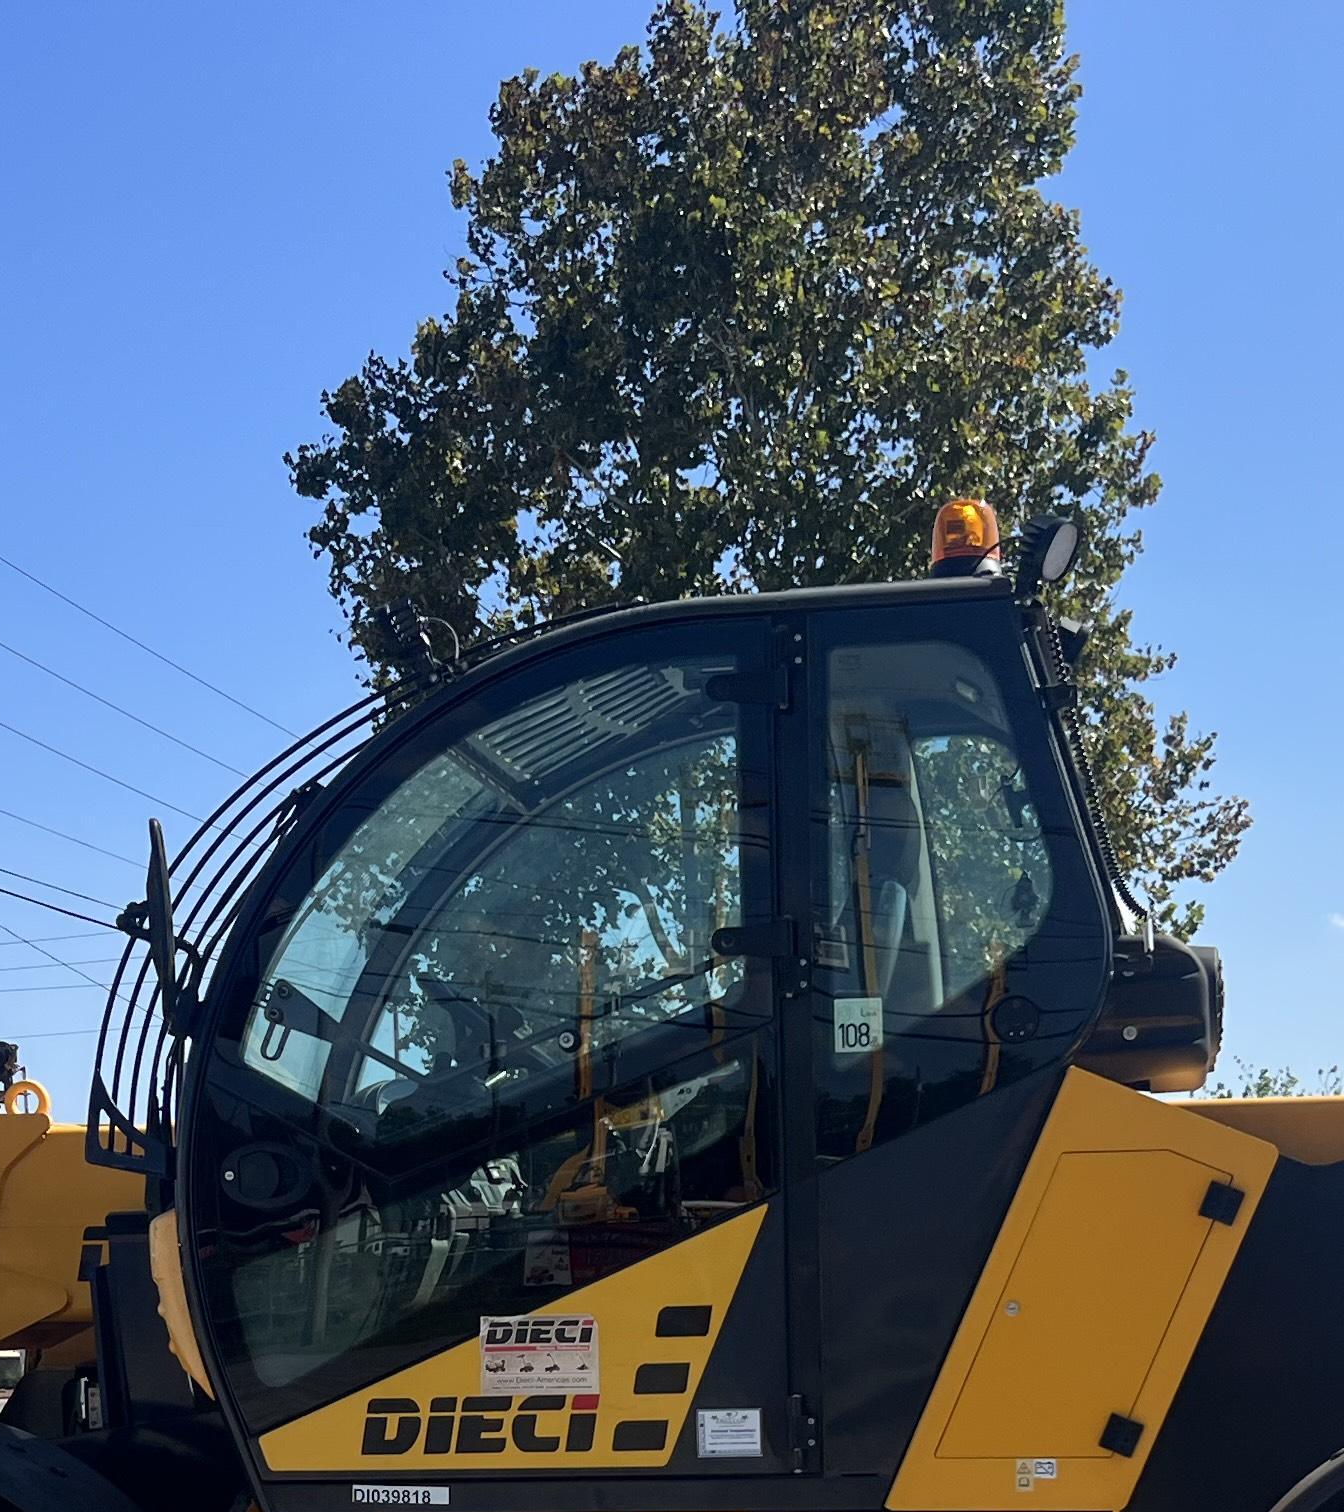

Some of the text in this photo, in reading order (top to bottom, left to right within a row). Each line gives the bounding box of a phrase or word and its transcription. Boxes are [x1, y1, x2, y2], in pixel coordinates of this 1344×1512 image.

[838, 1022, 870, 1049] 108
[485, 1319, 594, 1344] DIECI
[361, 1393, 600, 1455] DIECI
[353, 1488, 431, 1504] DI039818
